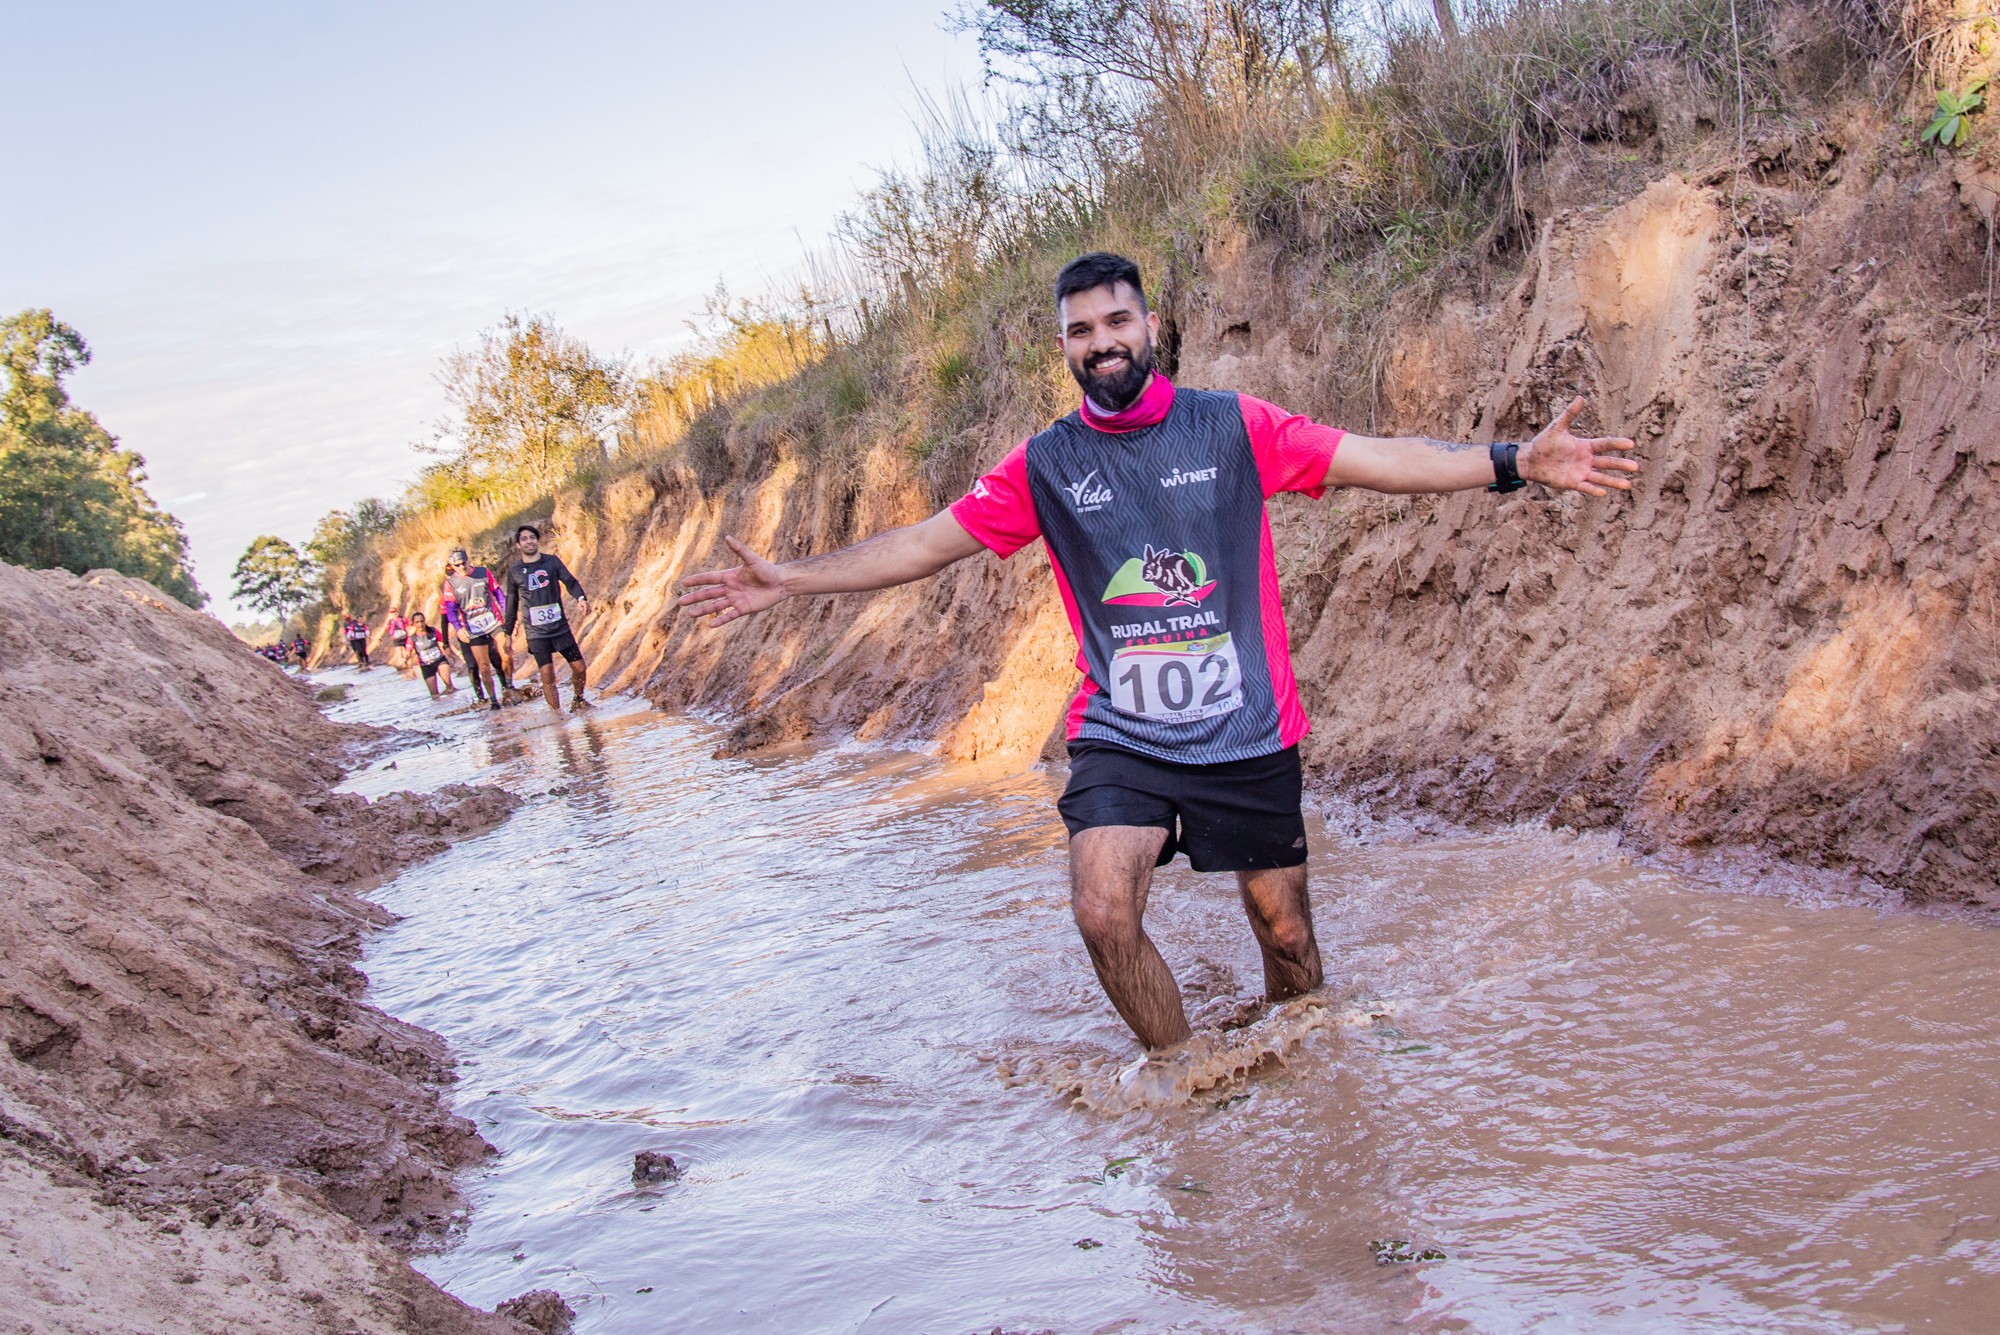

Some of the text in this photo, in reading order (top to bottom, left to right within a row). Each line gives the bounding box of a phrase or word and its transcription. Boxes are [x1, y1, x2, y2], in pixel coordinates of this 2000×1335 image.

[1063, 469, 1114, 506] Vida
[537, 608, 555, 622] 38
[1110, 610, 1220, 639] RURAL TRAIL
[1126, 628, 1208, 648] ESQUINA
[1119, 654, 1232, 714] 102
